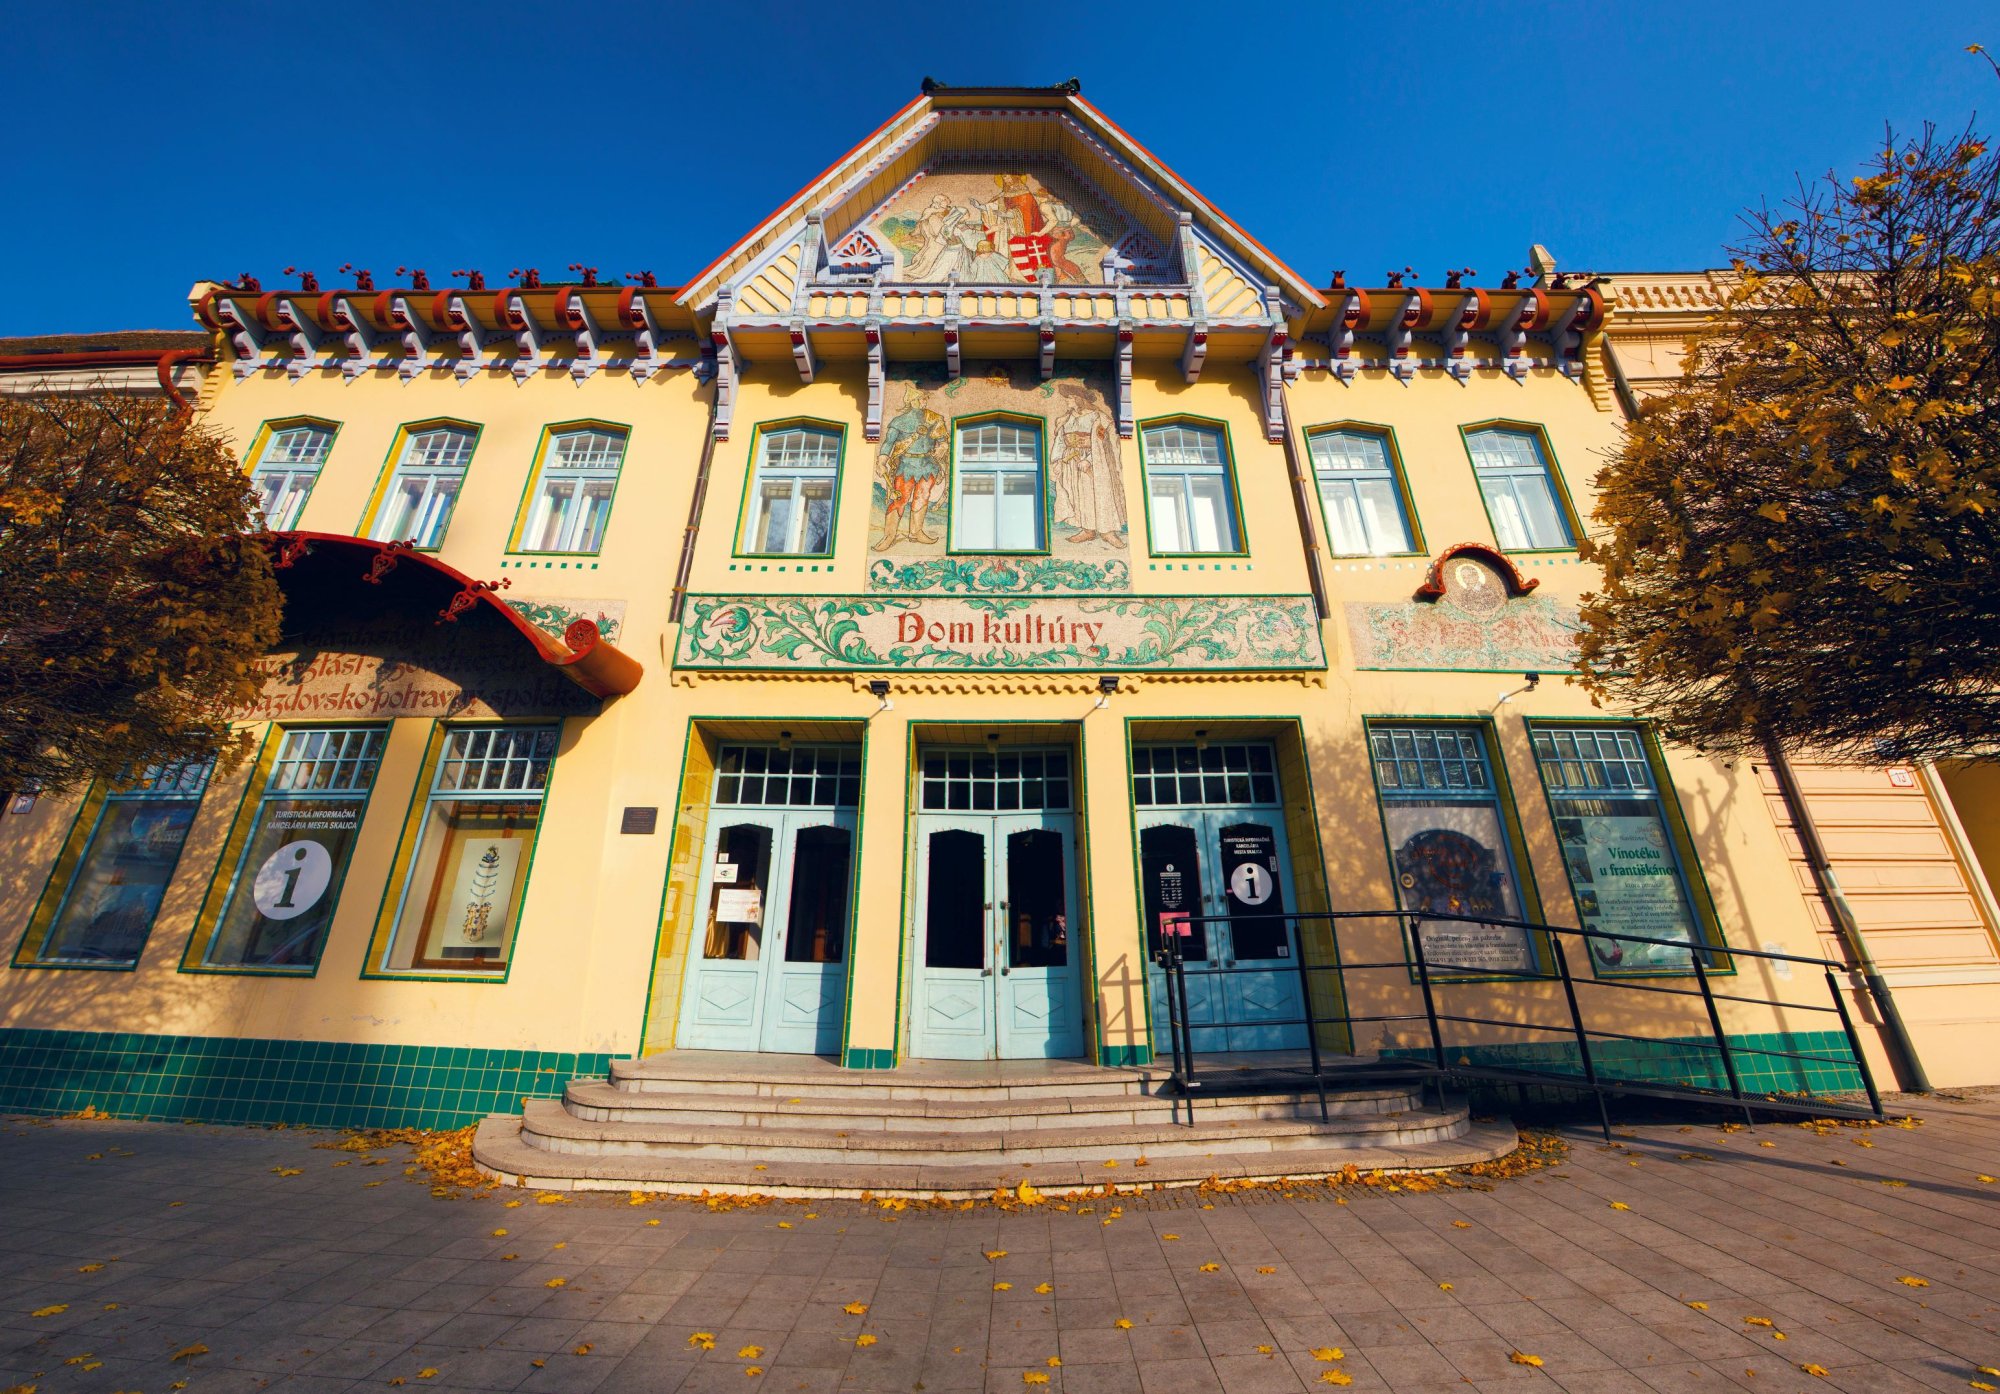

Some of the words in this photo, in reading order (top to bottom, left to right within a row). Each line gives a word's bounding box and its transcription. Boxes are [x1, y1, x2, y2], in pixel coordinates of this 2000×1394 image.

[892, 611, 974, 645] Dom
[982, 612, 1104, 652] kultúry
[275, 809, 312, 818] TURISTICKÁ
[312, 808, 356, 818] INFORMAČNÁ
[266, 820, 306, 829] KANCELÁRIA
[307, 821, 329, 829] MESTA
[329, 821, 357, 829] SKALICA
[1599, 867, 1608, 876] u
